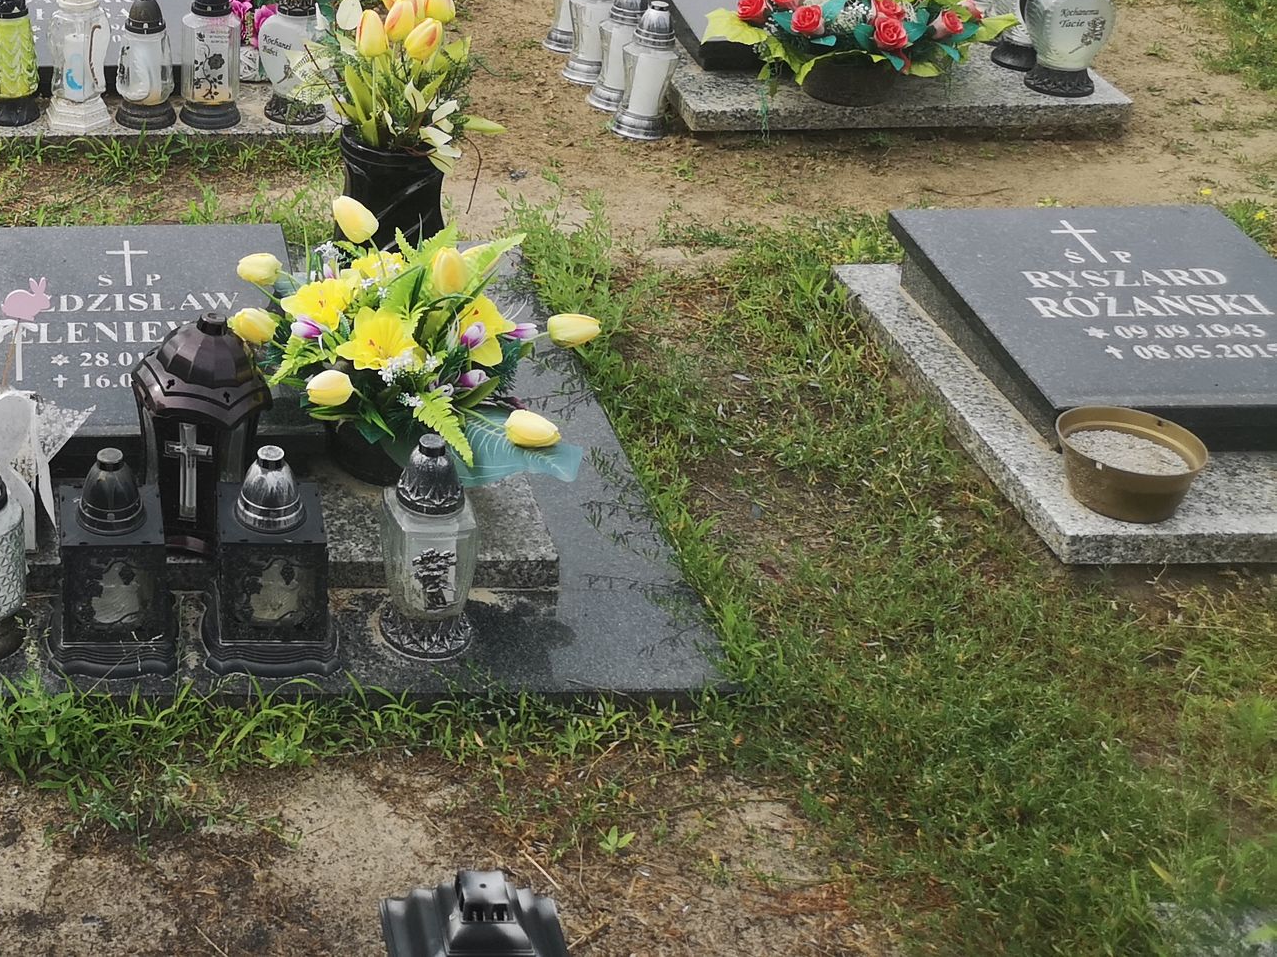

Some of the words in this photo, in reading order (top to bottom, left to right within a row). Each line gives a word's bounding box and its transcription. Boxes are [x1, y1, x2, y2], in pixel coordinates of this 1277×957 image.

[1110, 250, 1132, 264] P
[146, 273, 162, 287] P
[1021, 268, 1228, 288] RYSZARD
[38, 292, 239, 313] DZISŁAW
[1025, 289, 1275, 319] RÓŻAŃSKI
[1114, 323, 1266, 339] 09.09.1943
